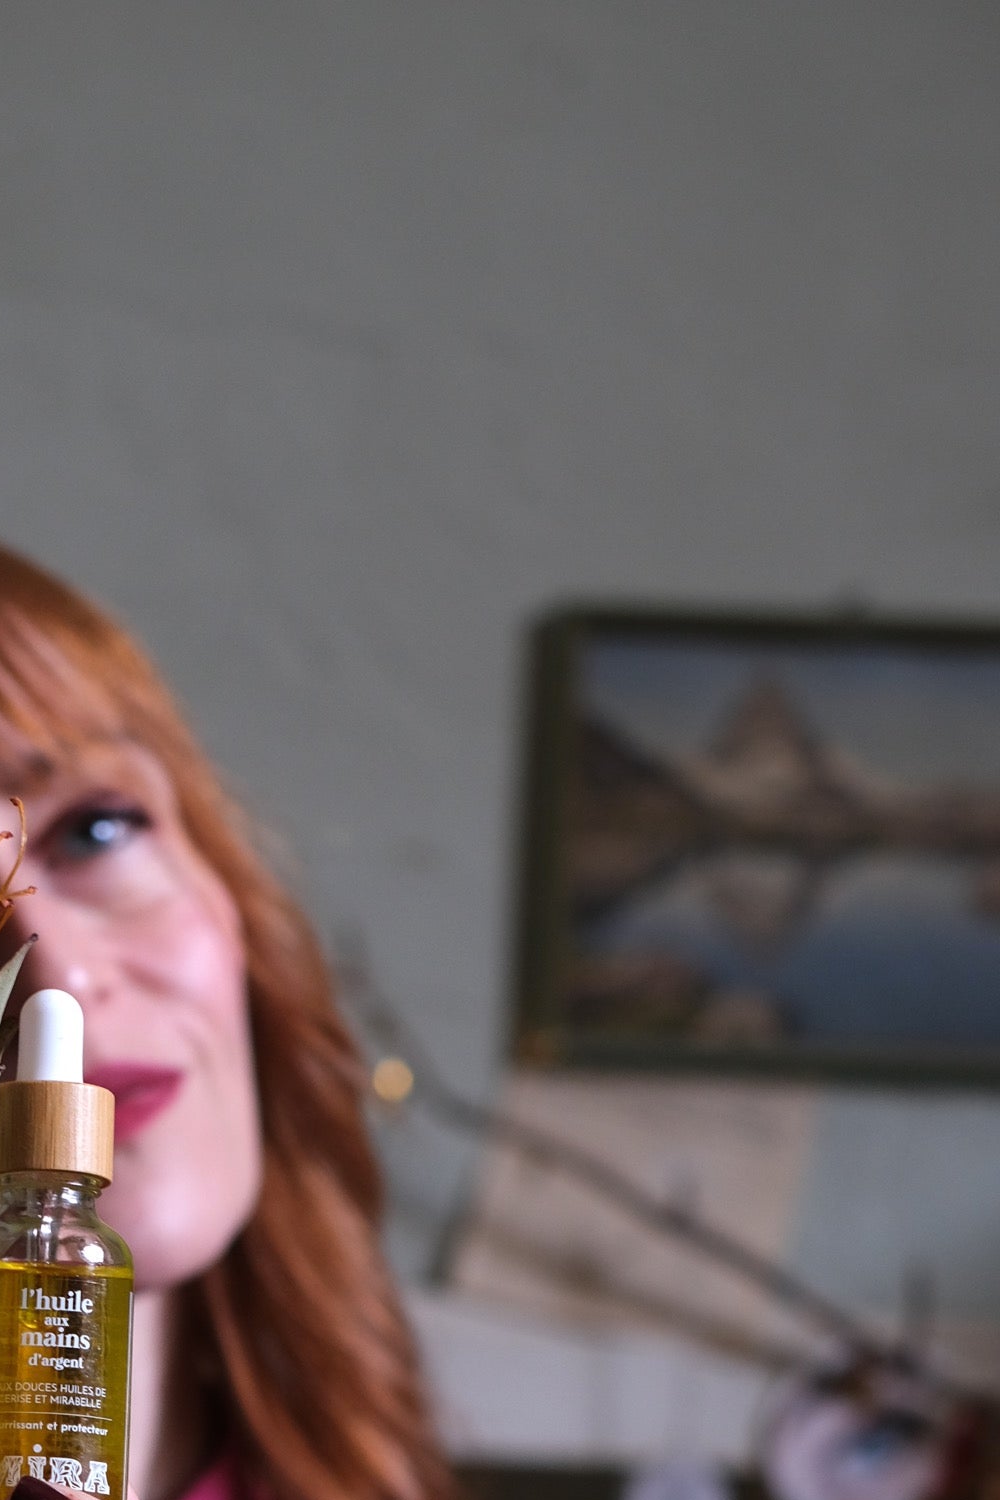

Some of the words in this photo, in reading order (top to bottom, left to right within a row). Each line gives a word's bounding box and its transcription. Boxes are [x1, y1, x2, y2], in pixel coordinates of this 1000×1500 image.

[44, 1315, 70, 1327] aux
[20, 1327, 91, 1350] mains
[15, 1382, 58, 1393] DOUCES
[59, 1384, 94, 1396] HUILES
[94, 1387, 107, 1398] DE
[34, 1395, 48, 1404] ET
[50, 1395, 102, 1409] MIRABELLE
[46, 1421, 58, 1431] et
[61, 1423, 108, 1436] protecteur
